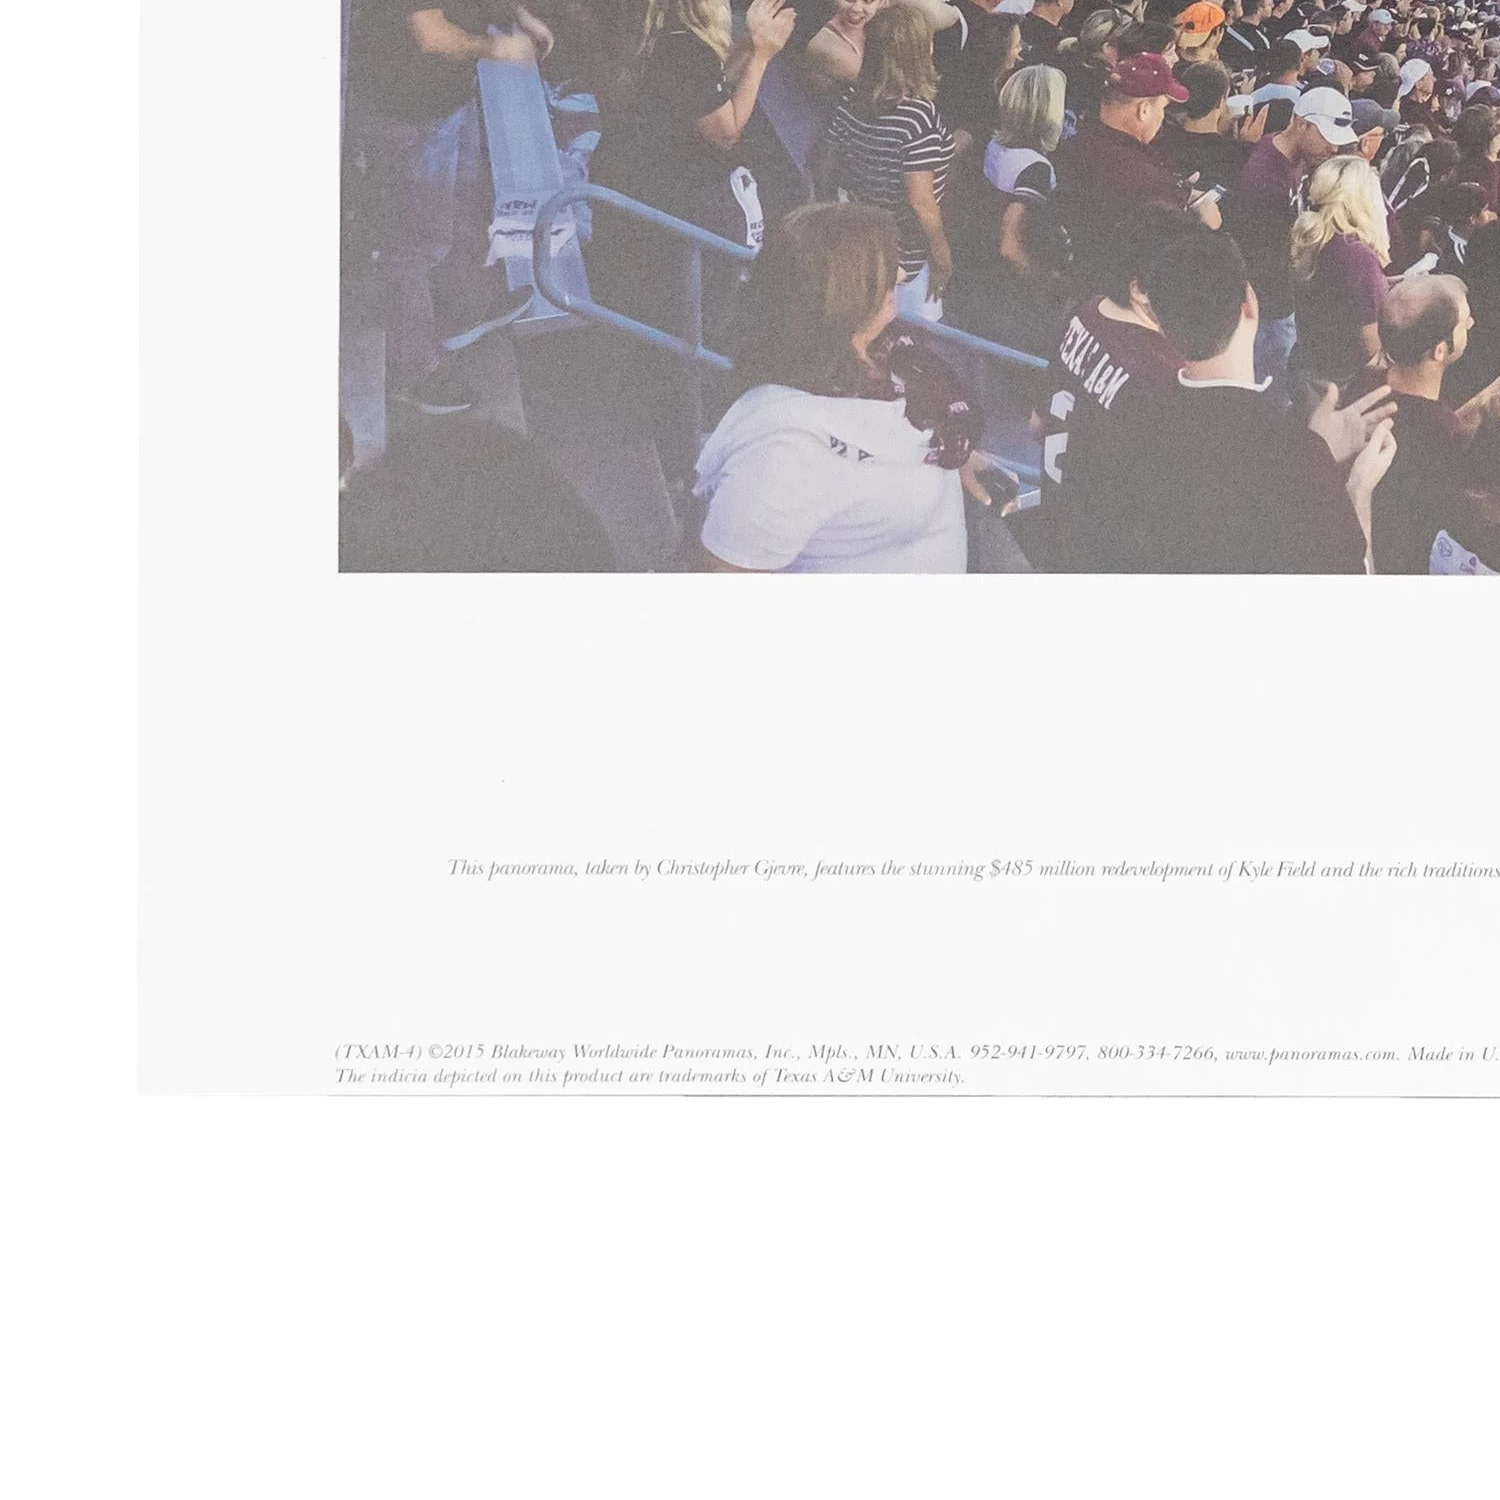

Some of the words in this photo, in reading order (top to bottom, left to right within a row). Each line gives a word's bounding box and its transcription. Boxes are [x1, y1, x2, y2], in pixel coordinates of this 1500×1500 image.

[448, 859, 484, 875] This
[488, 861, 578, 881] panorama,
[585, 859, 628, 875] taken
[634, 859, 651, 881] by
[657, 859, 750, 881] Christopher
[811, 859, 875, 881] features
[881, 860, 905, 876] the
[909, 860, 986, 881] stunning
[989, 859, 1033, 878] $485
[1040, 860, 1095, 876] million
[1101, 860, 1213, 882] redevelopment
[1218, 860, 1237, 882] of
[1238, 861, 1273, 882] Kyle
[1277, 860, 1316, 877] Field
[1321, 861, 1354, 877] and
[1359, 861, 1383, 877] the
[1388, 862, 1417, 877] rich
[1423, 862, 1500, 878] traditions
[335, 1044, 422, 1061] (TXAM-4)
[428, 1044, 484, 1059] ©2015
[491, 1044, 566, 1063] Blakeway
[574, 1044, 657, 1059] Worldwide
[662, 1044, 757, 1060] Panoramas,
[765, 1044, 800, 1061] Inc.,
[808, 1044, 858, 1064] Mpls.,
[866, 1044, 901, 1061] MN,
[910, 1044, 960, 1059] U.S.A.
[971, 1044, 1089, 1060] 952-941-9797,
[1097, 1044, 1217, 1062] 800-334-7266,
[1225, 1048, 1399, 1066] www.panoramas.com.
[1408, 1046, 1453, 1061] Made
[1459, 1047, 1474, 1061] in
[336, 1068, 366, 1083] The
[371, 1068, 427, 1084] indicia
[433, 1068, 497, 1086] depicted
[503, 1073, 522, 1083] on
[529, 1068, 557, 1082] this
[562, 1068, 623, 1087] product
[629, 1072, 653, 1082] are
[659, 1068, 746, 1083] trademarks
[752, 1068, 770, 1087] of
[774, 1068, 816, 1084] Texas
[823, 1068, 874, 1083] A&M
[881, 1068, 964, 1087] University.
